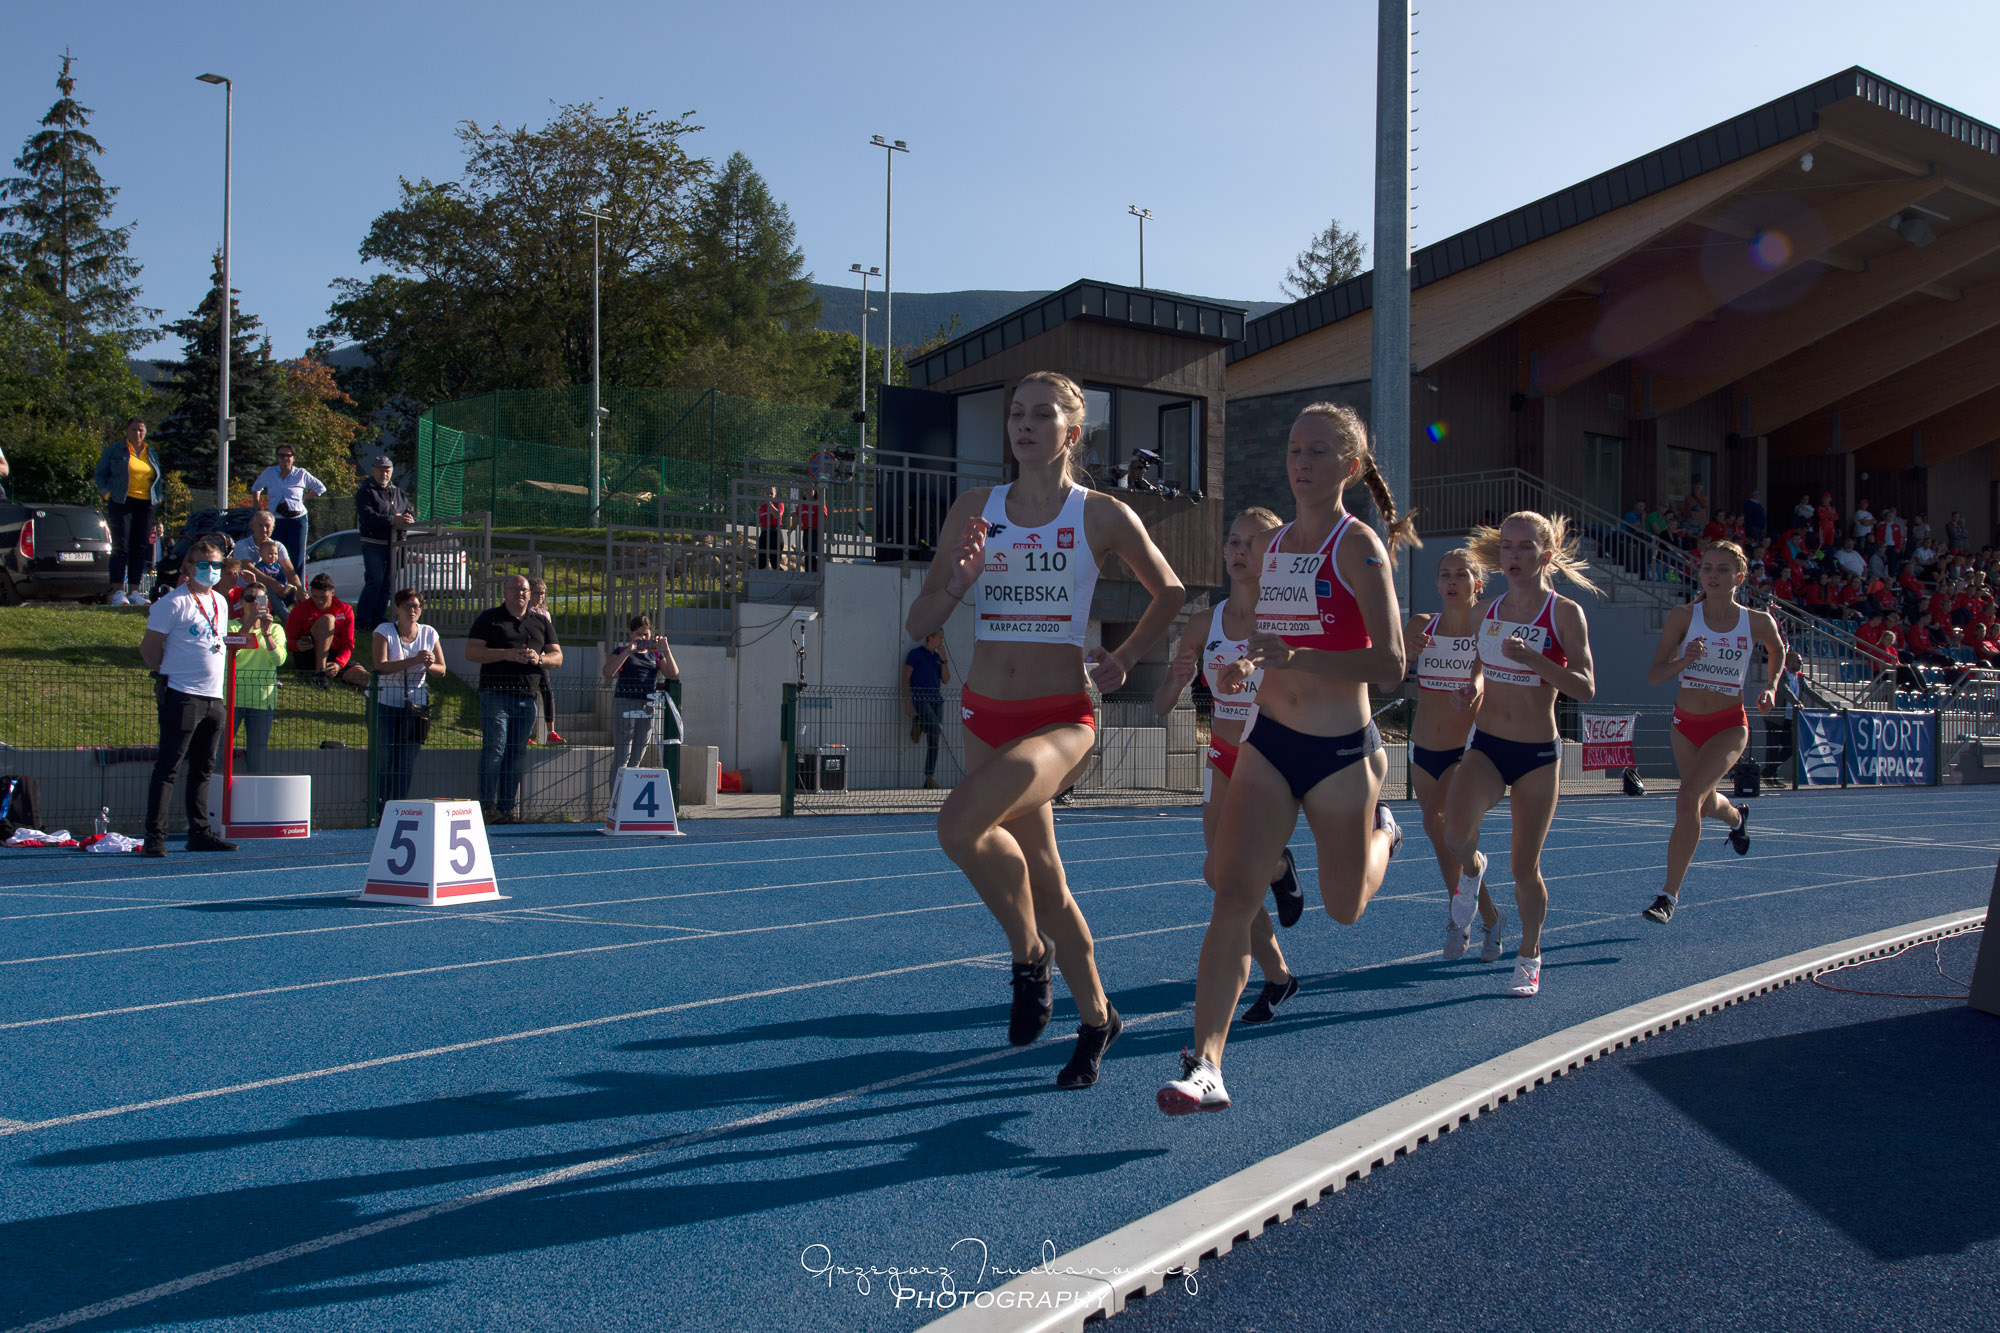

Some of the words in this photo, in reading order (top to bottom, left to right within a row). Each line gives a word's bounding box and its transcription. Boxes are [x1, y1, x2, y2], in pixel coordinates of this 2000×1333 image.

[1025, 552, 1067, 571] 110
[1289, 557, 1320, 574] 510
[985, 585, 1069, 605] PORĘBSKA
[990, 622, 1033, 632] KARPACZ
[1035, 623, 1060, 632] 2020
[1289, 622, 1310, 631] 2020
[1511, 626, 1540, 642] 602
[1717, 648, 1743, 661] 109
[1427, 681, 1456, 689] KARPACZ
[1512, 674, 1530, 682] 2020
[1690, 681, 1718, 692] KARPACZ
[1718, 686, 1732, 694] 2020
[1857, 718, 1925, 751] SPORT
[1857, 756, 1924, 777] KARPACZ
[632, 781, 660, 818] 4
[400, 808, 424, 817] polanik
[451, 807, 473, 818] polanik
[387, 819, 419, 876] 5
[449, 819, 476, 875] 5
